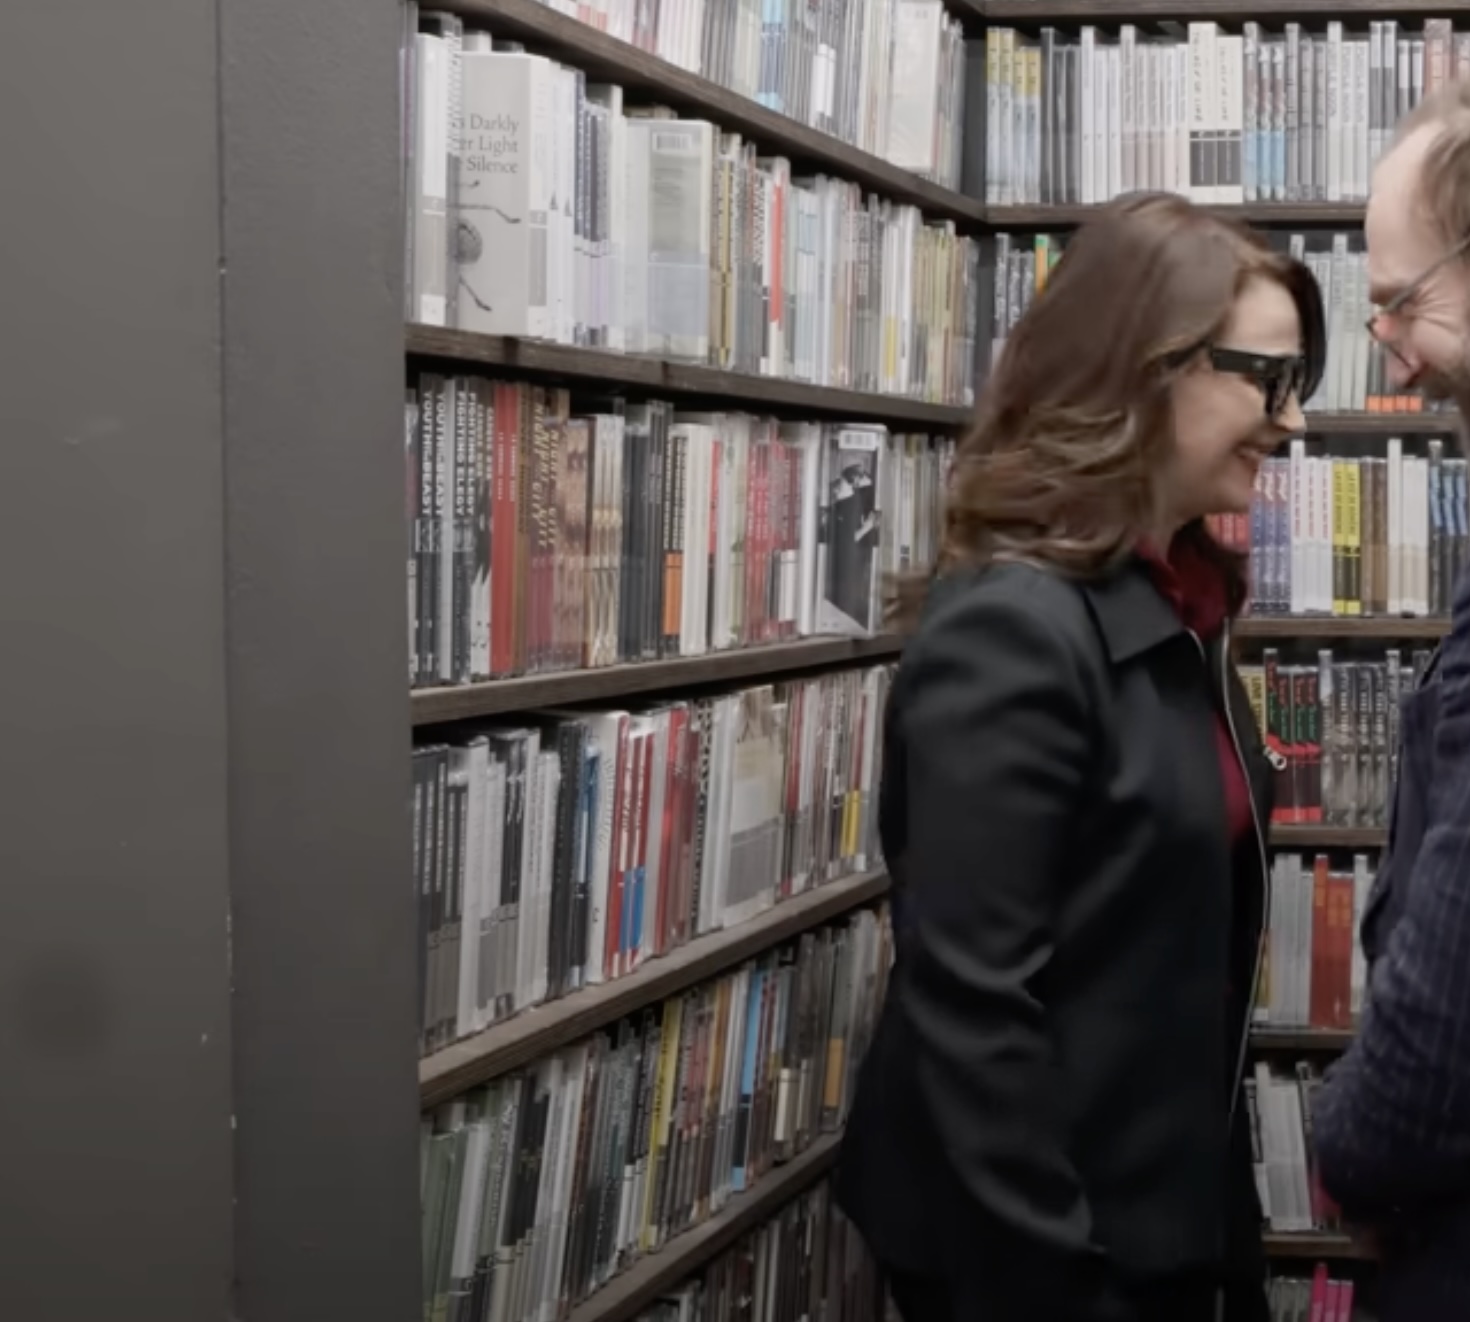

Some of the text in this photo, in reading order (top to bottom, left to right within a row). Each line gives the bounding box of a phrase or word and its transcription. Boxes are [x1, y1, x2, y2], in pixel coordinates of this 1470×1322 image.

[466, 155, 518, 173] Silence
[470, 113, 519, 136] Darkly
[479, 135, 518, 157] Light
[421, 391, 432, 516] YOUTH BEAST
[435, 392, 446, 516] YOUTH BEAST
[456, 391, 465, 516] FIGHTING ELEGY
[467, 392, 477, 516] FIGHTING ELEGY
